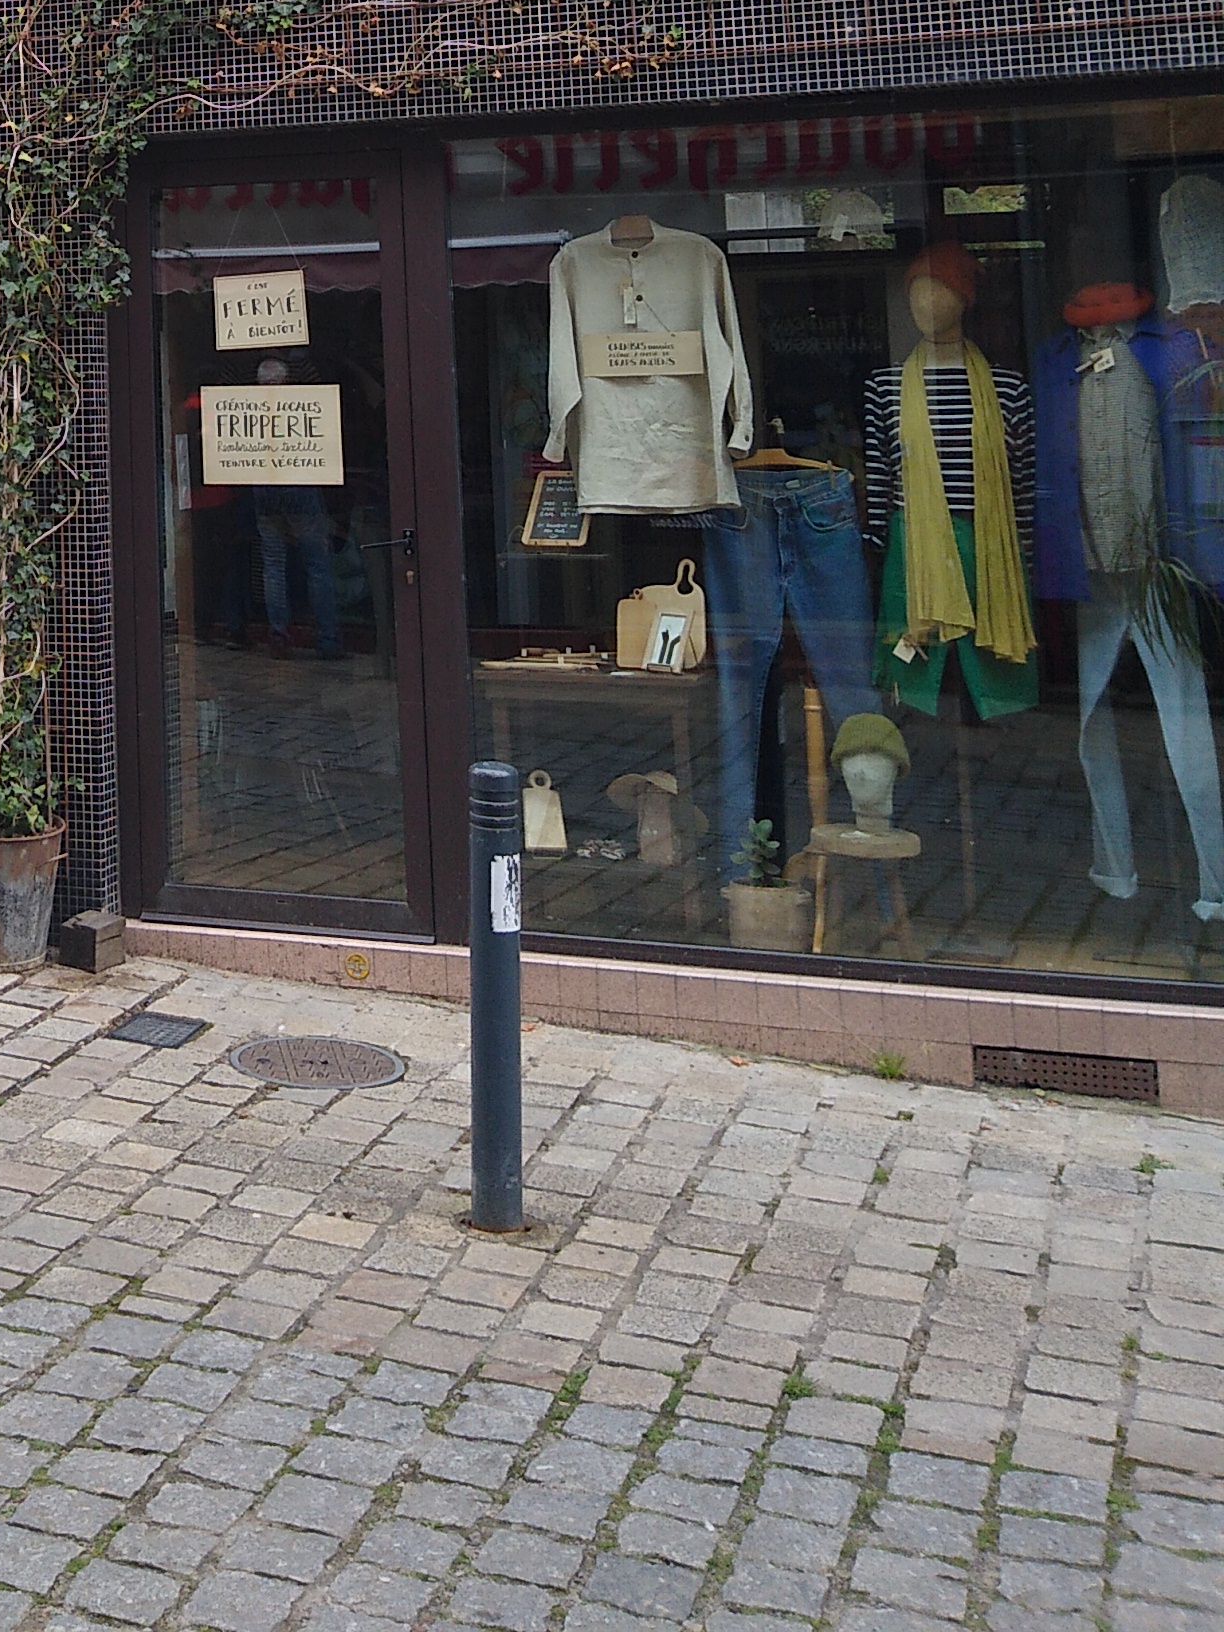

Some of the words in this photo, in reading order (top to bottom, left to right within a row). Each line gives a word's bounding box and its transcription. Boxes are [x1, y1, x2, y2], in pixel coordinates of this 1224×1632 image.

[223, 289, 300, 318] FERMÉ
[227, 323, 236, 339] À
[216, 398, 271, 412] CRÉATIONS
[276, 401, 322, 413] LOCALES
[217, 412, 324, 439] FRIPPERIE
[219, 459, 266, 468] TEINTURE
[271, 455, 326, 468] VÉGÉTALE
